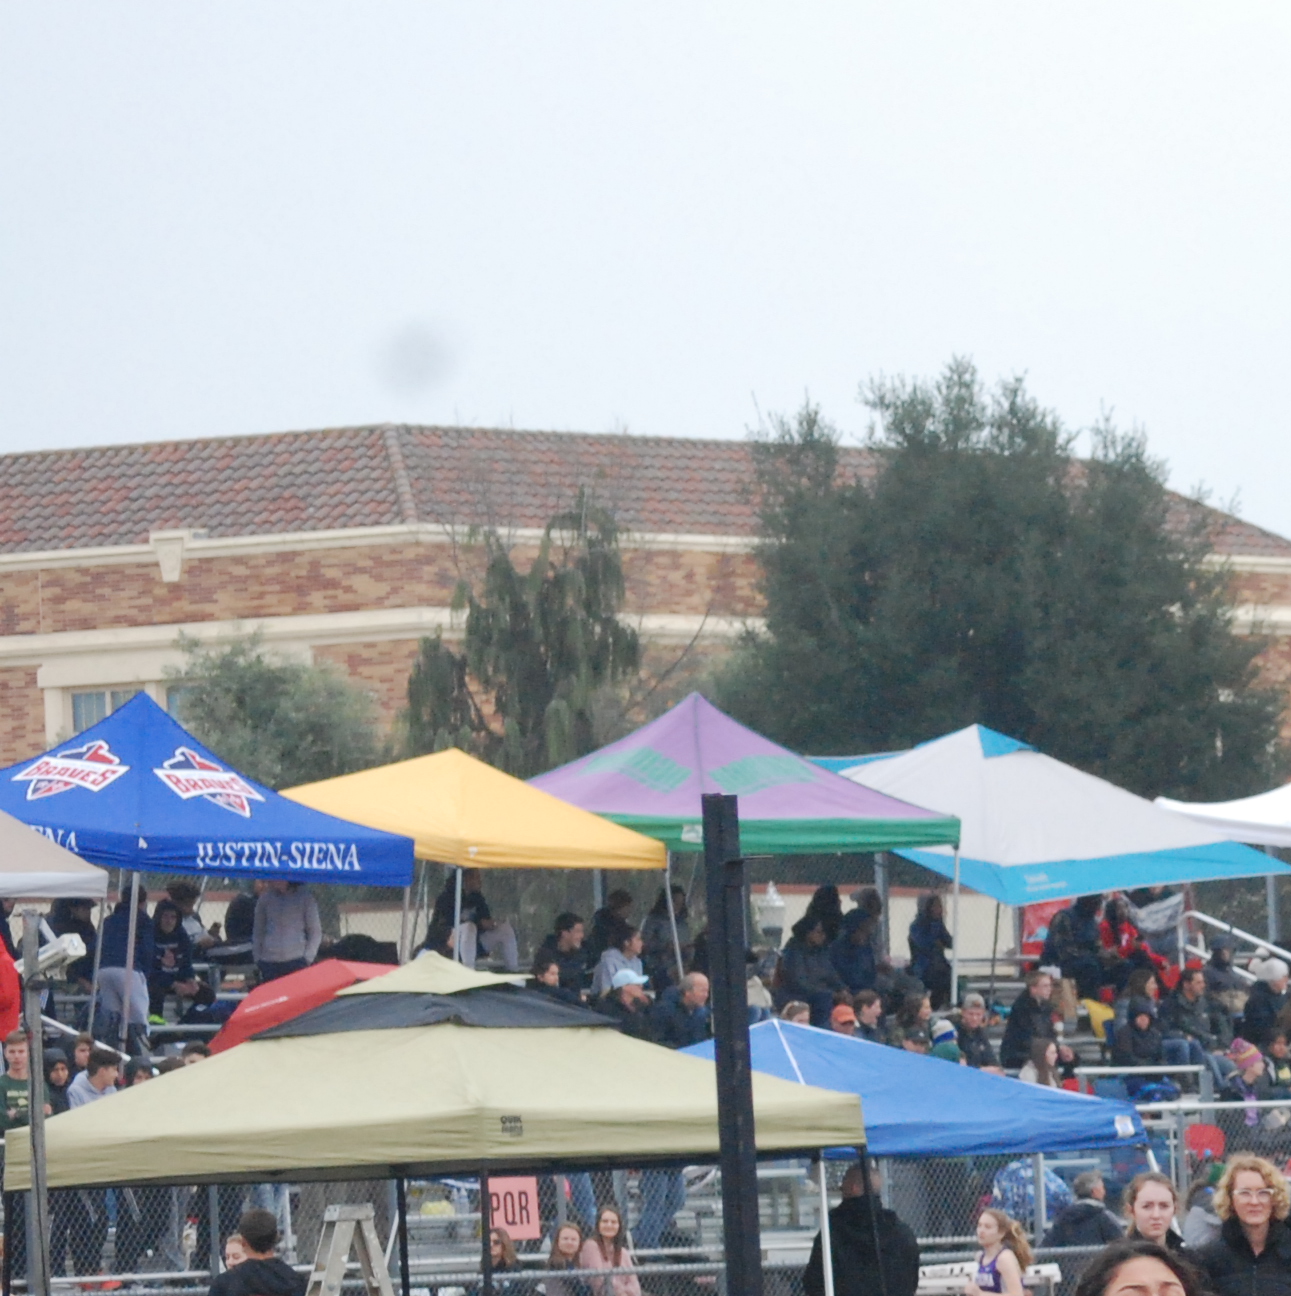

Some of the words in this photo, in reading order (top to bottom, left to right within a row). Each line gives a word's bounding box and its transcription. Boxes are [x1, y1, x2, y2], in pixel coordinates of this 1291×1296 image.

[22, 760, 117, 788] BRAVES
[164, 772, 252, 796] BRAVES
[196, 841, 362, 871] JUSTIN-SIENA
[490, 1190, 531, 1227] PQR
